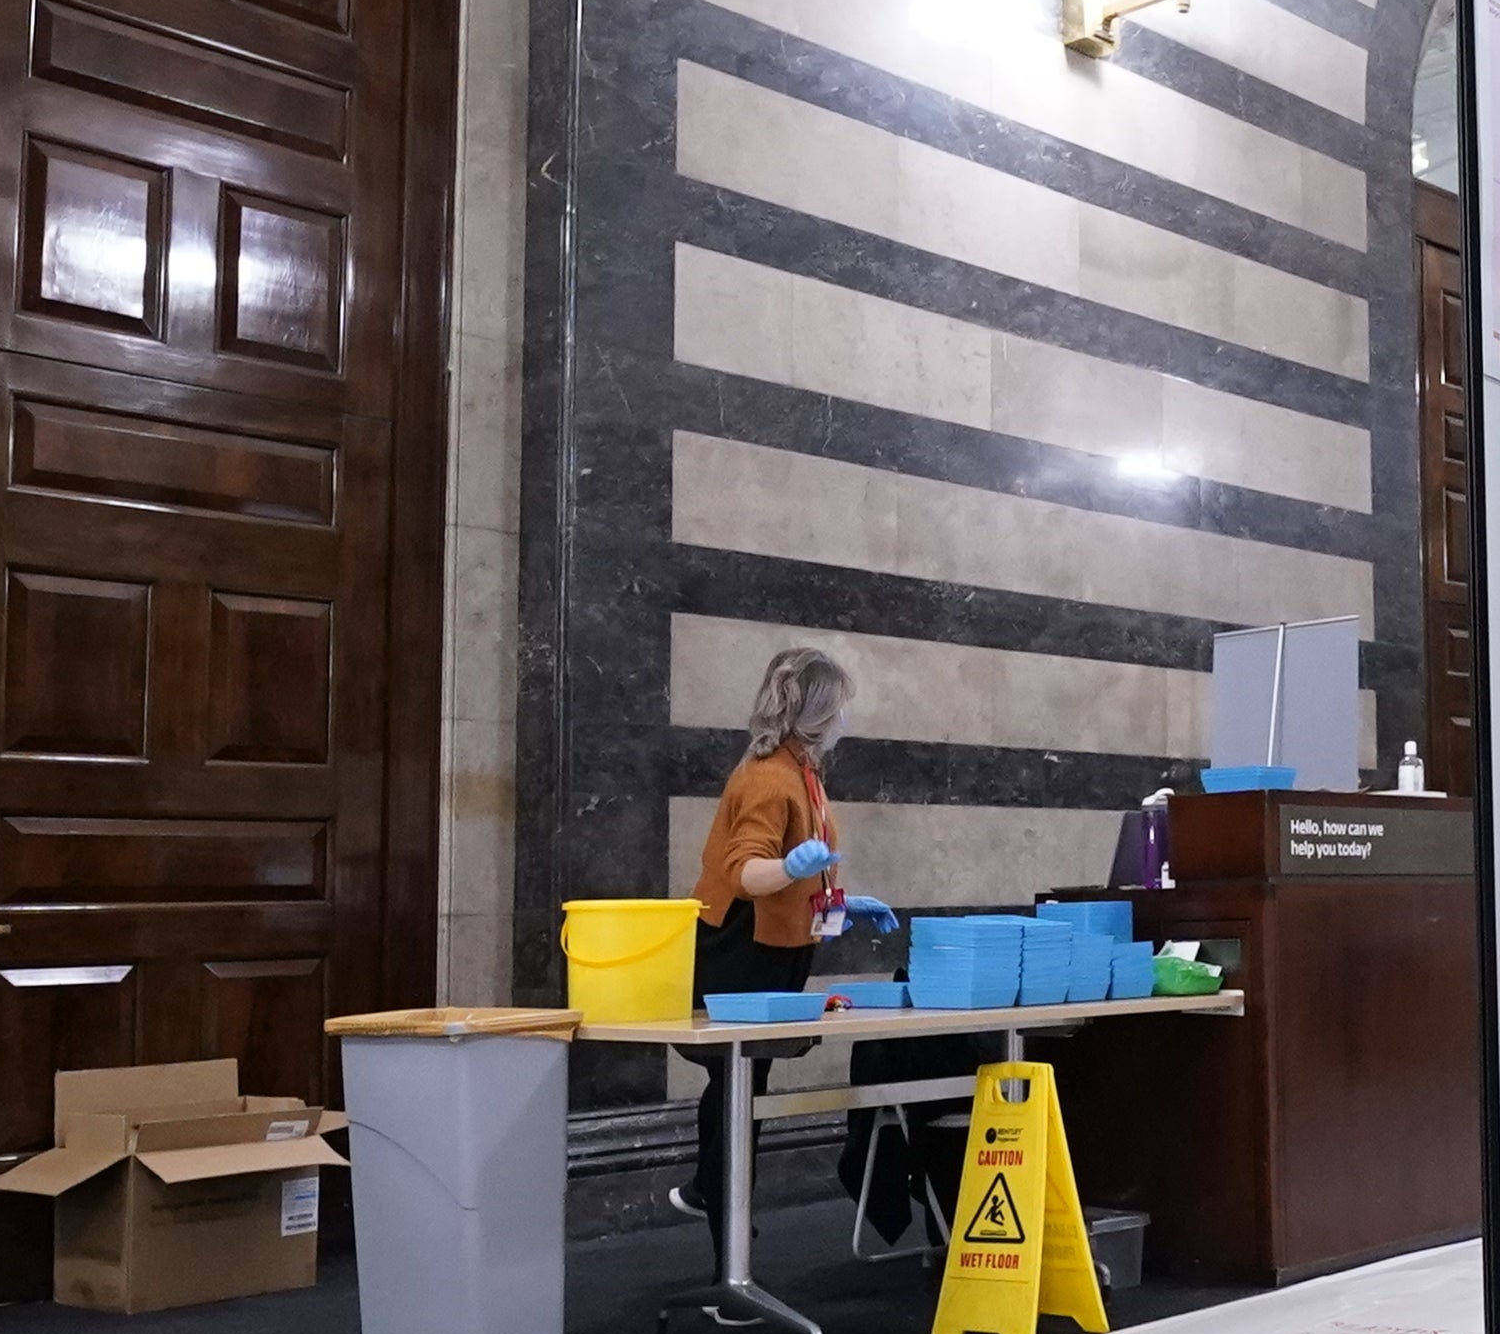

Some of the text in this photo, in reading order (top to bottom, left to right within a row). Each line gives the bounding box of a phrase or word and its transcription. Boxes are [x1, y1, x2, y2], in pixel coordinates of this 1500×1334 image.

[1290, 819, 1384, 837] Hello, how can we
[1290, 840, 1373, 859] help you today?
[977, 1150, 1024, 1166] CAUTION
[960, 1253, 1020, 1270] WET FLOOR
